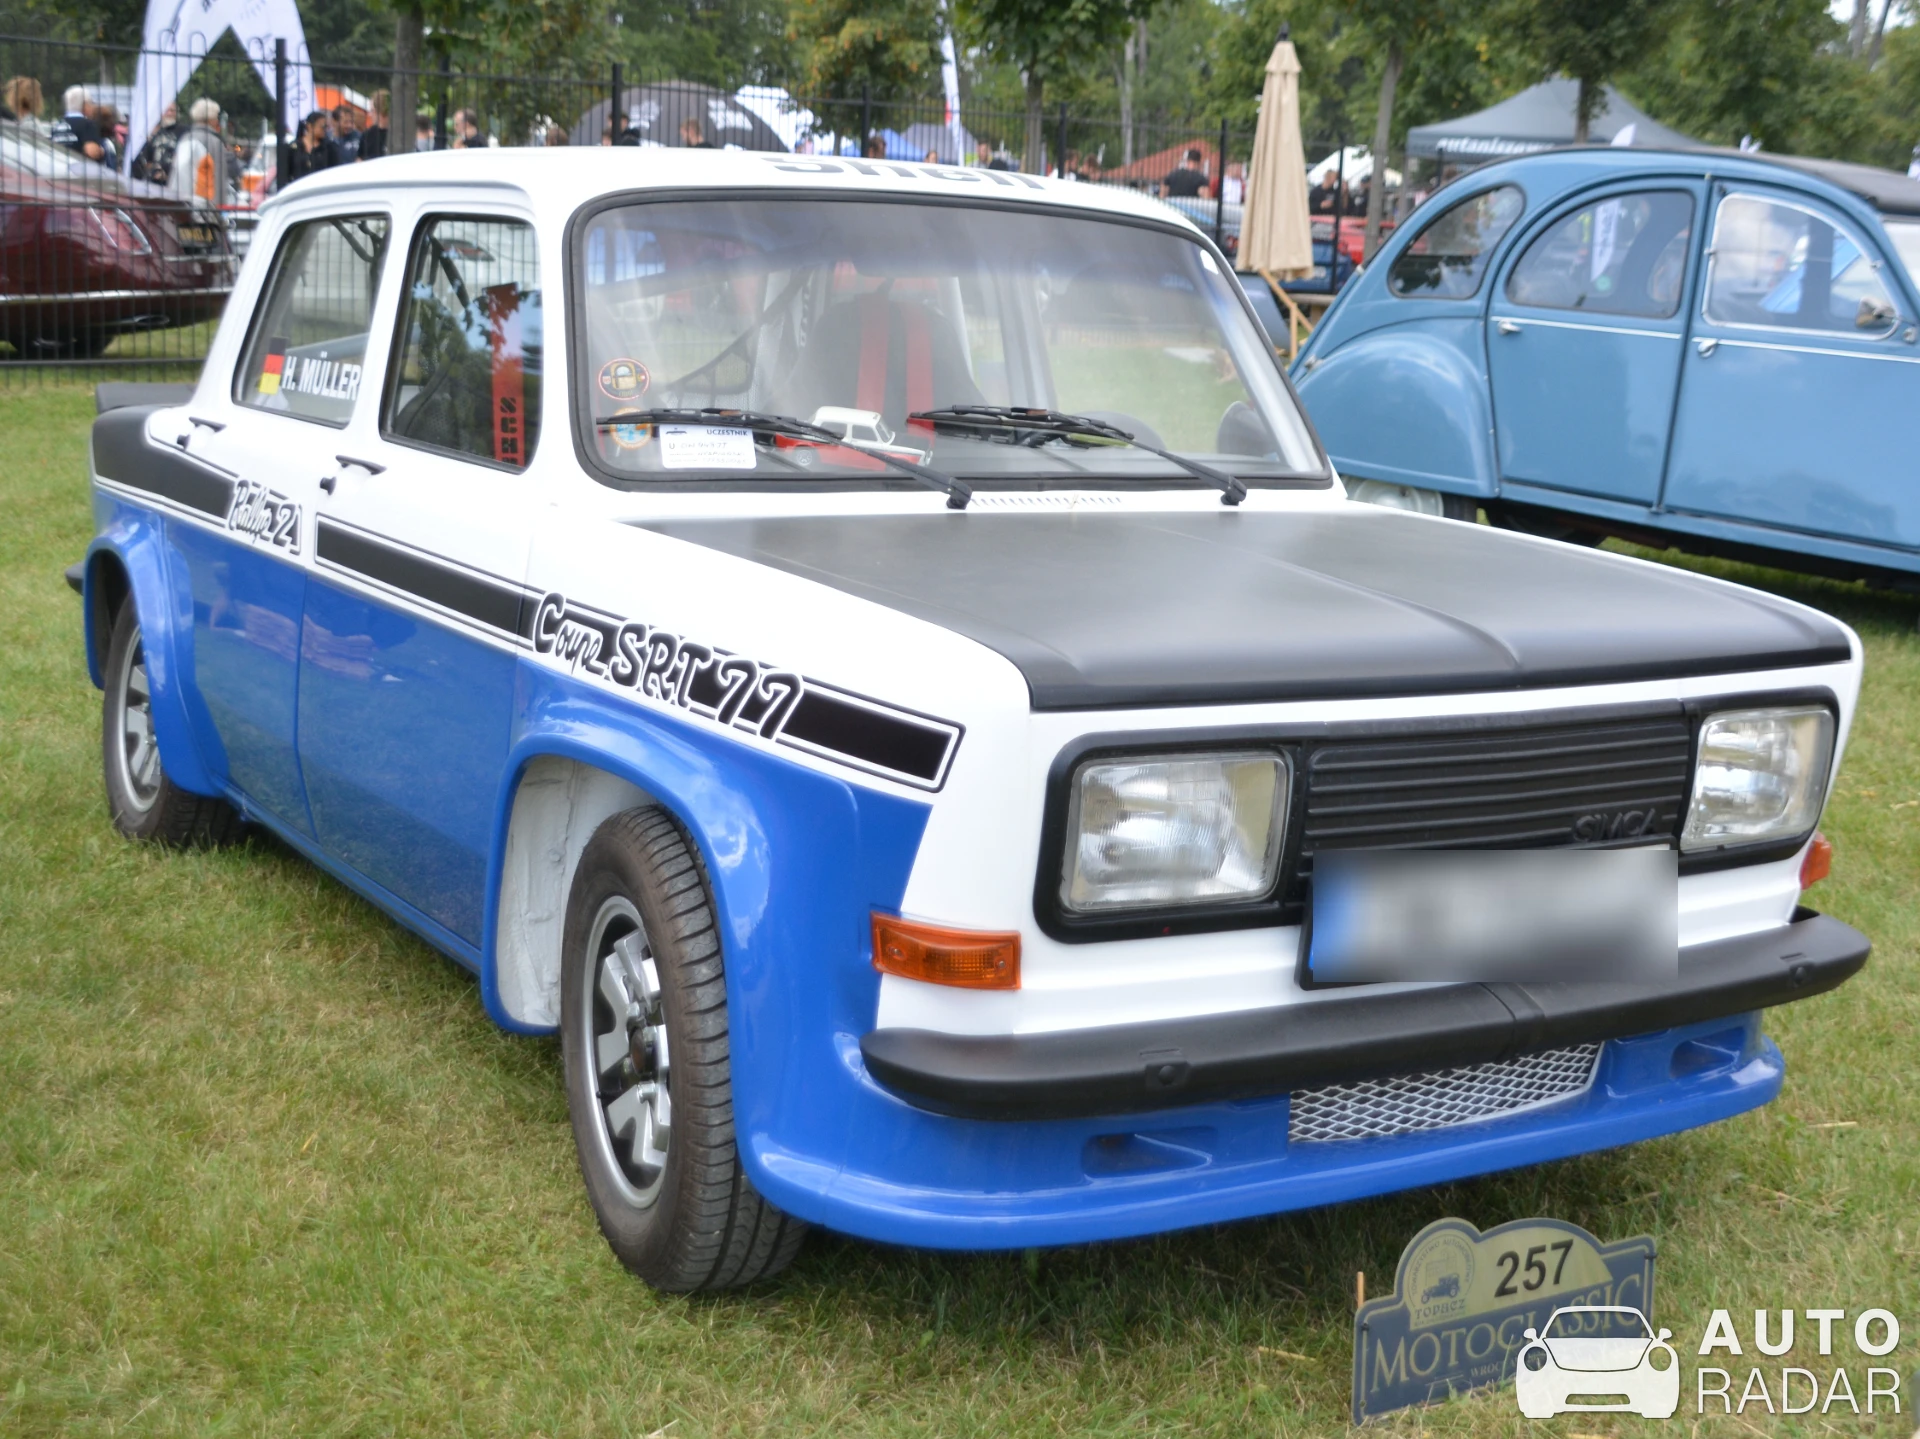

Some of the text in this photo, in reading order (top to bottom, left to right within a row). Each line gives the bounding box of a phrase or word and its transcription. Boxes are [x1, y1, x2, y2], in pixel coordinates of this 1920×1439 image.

[761, 156, 1046, 190] Shell
[282, 351, 362, 401] H. MÜLLER
[706, 428, 748, 437] UCZESTNIK
[272, 503, 297, 548] 2
[611, 623, 712, 708] SRT
[718, 659, 801, 740] 77
[1493, 1239, 1575, 1298] 257
